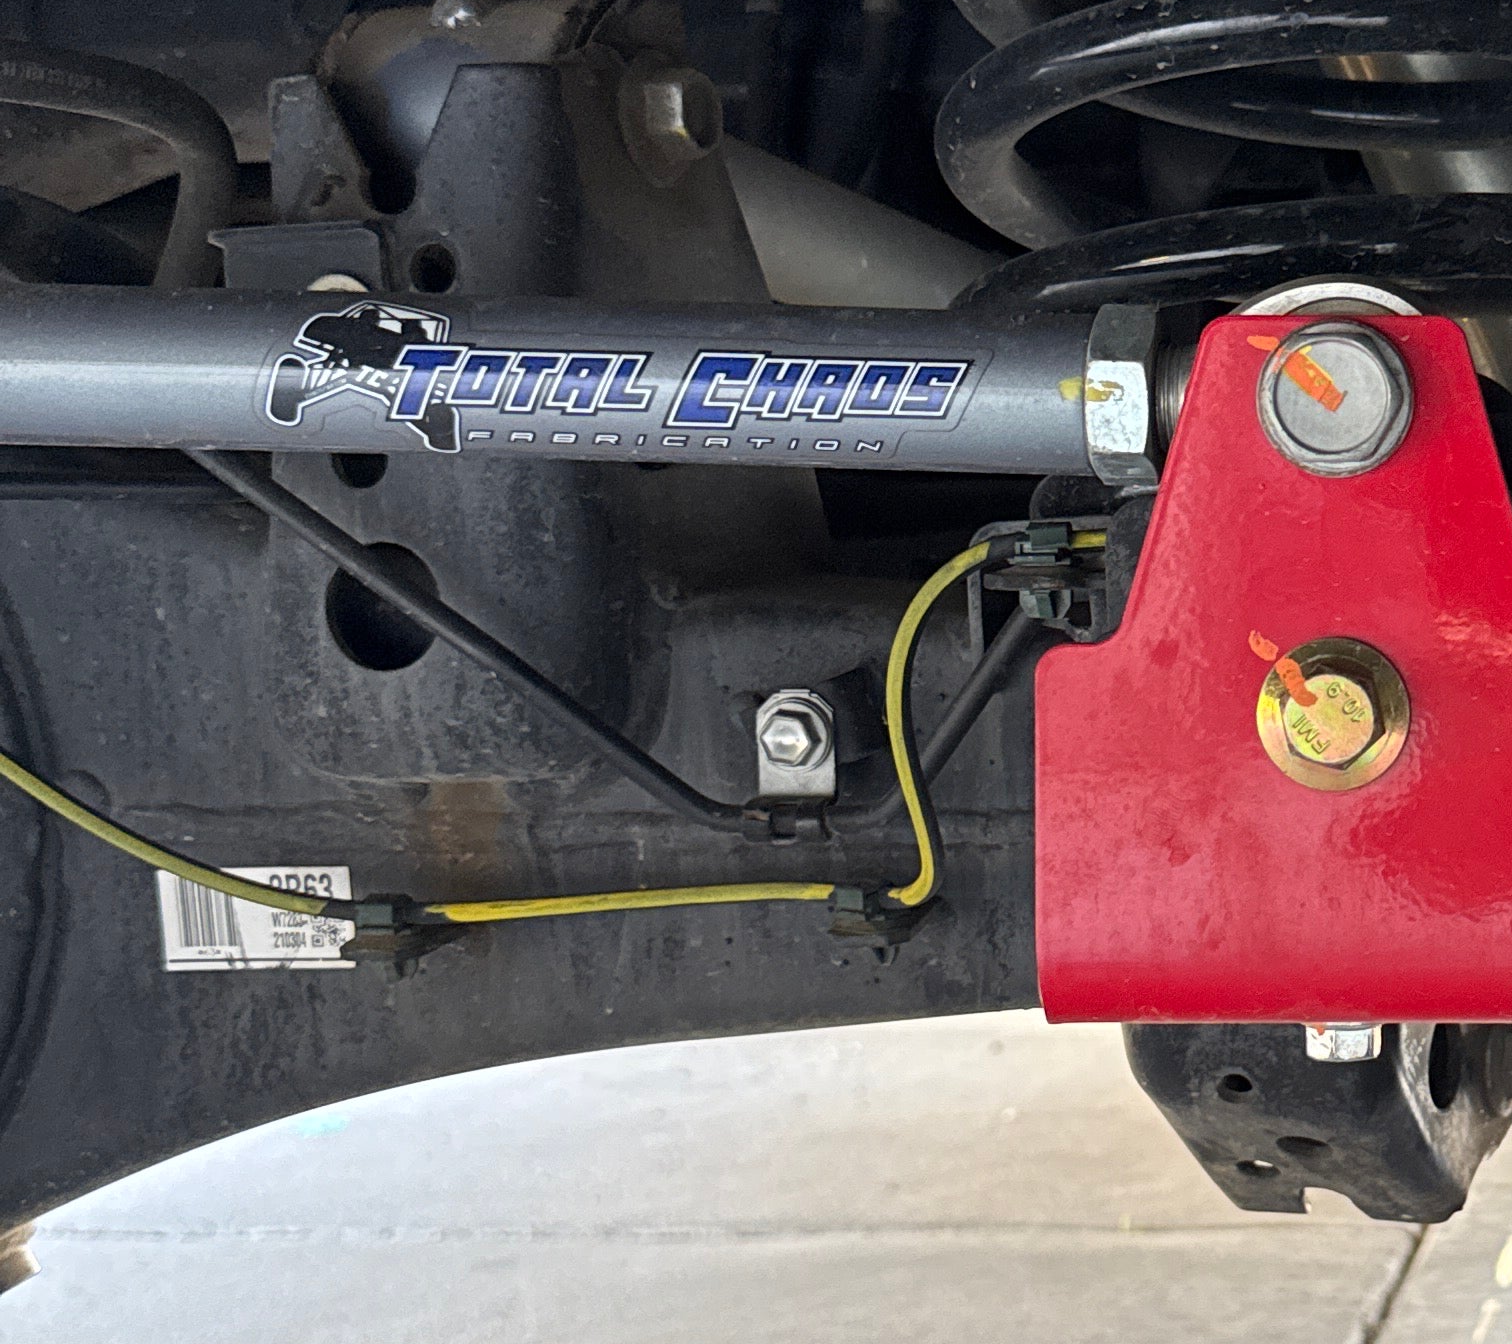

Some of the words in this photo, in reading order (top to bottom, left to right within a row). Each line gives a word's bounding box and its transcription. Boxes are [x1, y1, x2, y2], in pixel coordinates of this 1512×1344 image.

[390, 344, 653, 422] TOTAL
[664, 349, 976, 428] CHAOS
[465, 428, 887, 454] FABRICATION
